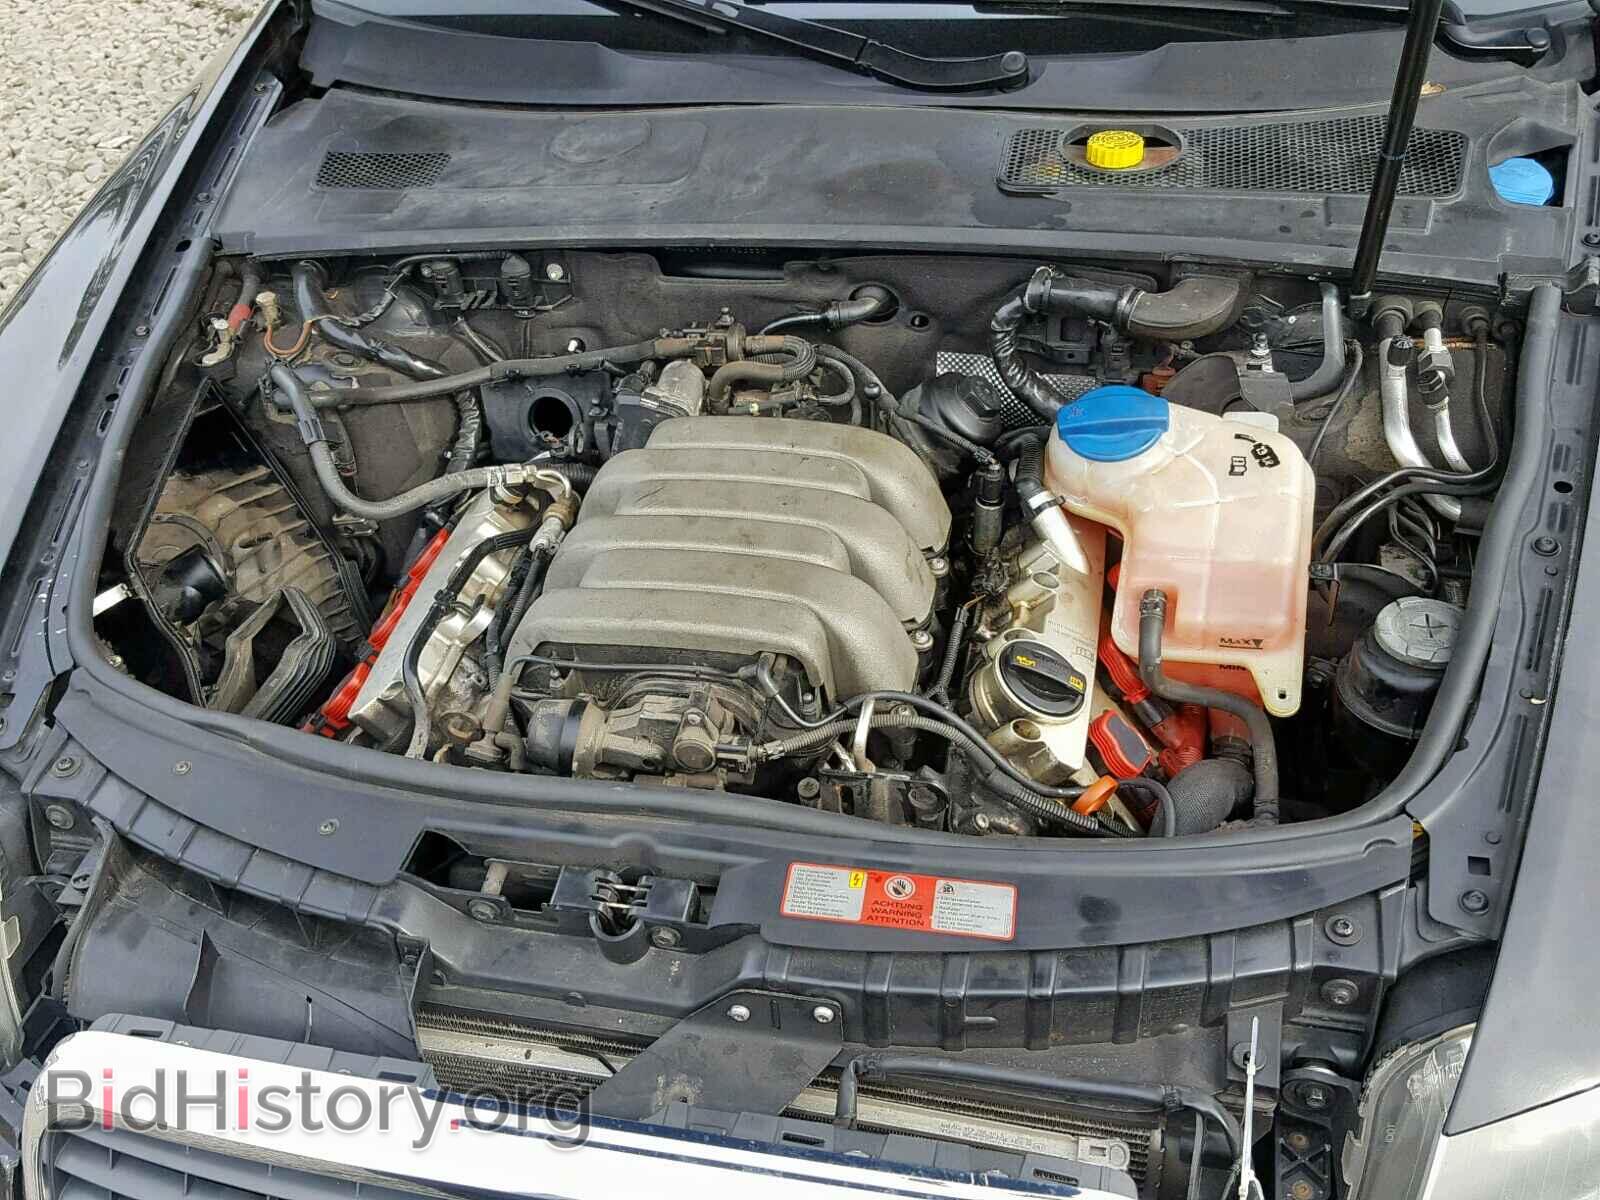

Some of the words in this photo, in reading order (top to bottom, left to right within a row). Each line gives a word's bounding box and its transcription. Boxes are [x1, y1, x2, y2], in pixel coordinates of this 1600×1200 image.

[1219, 637, 1251, 646] MAX
[872, 900, 923, 911] ACHTUNG
[871, 907, 922, 919] WARNING
[866, 915, 925, 927] ATTENTION
